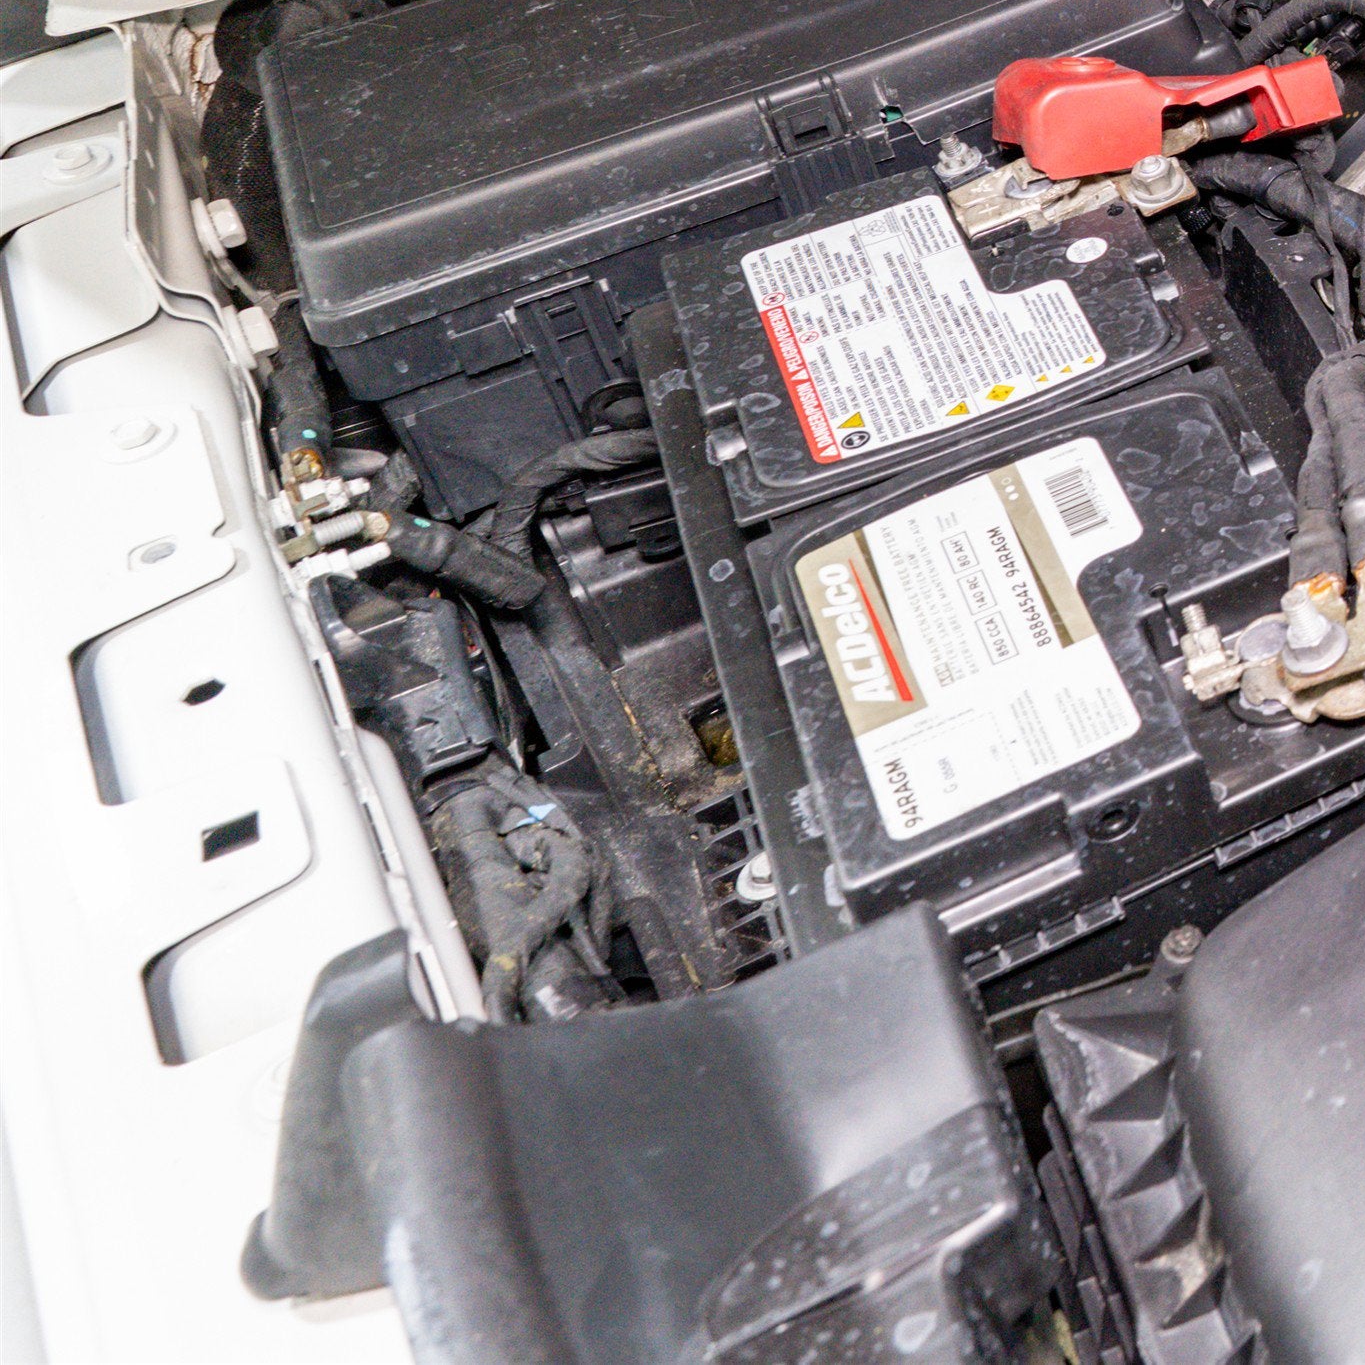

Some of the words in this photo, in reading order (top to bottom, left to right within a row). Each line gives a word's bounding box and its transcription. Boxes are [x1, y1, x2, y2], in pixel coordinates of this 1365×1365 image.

[956, 552, 971, 568] 80
[985, 524, 1020, 579] 94RAGM
[965, 574, 980, 591] RC
[972, 588, 988, 609] 140
[1010, 579, 1052, 648] 88864542
[817, 563, 897, 703] ACDelco
[984, 616, 1001, 639] CCA
[992, 636, 1009, 658] 850
[882, 754, 924, 830] 94RAGM
